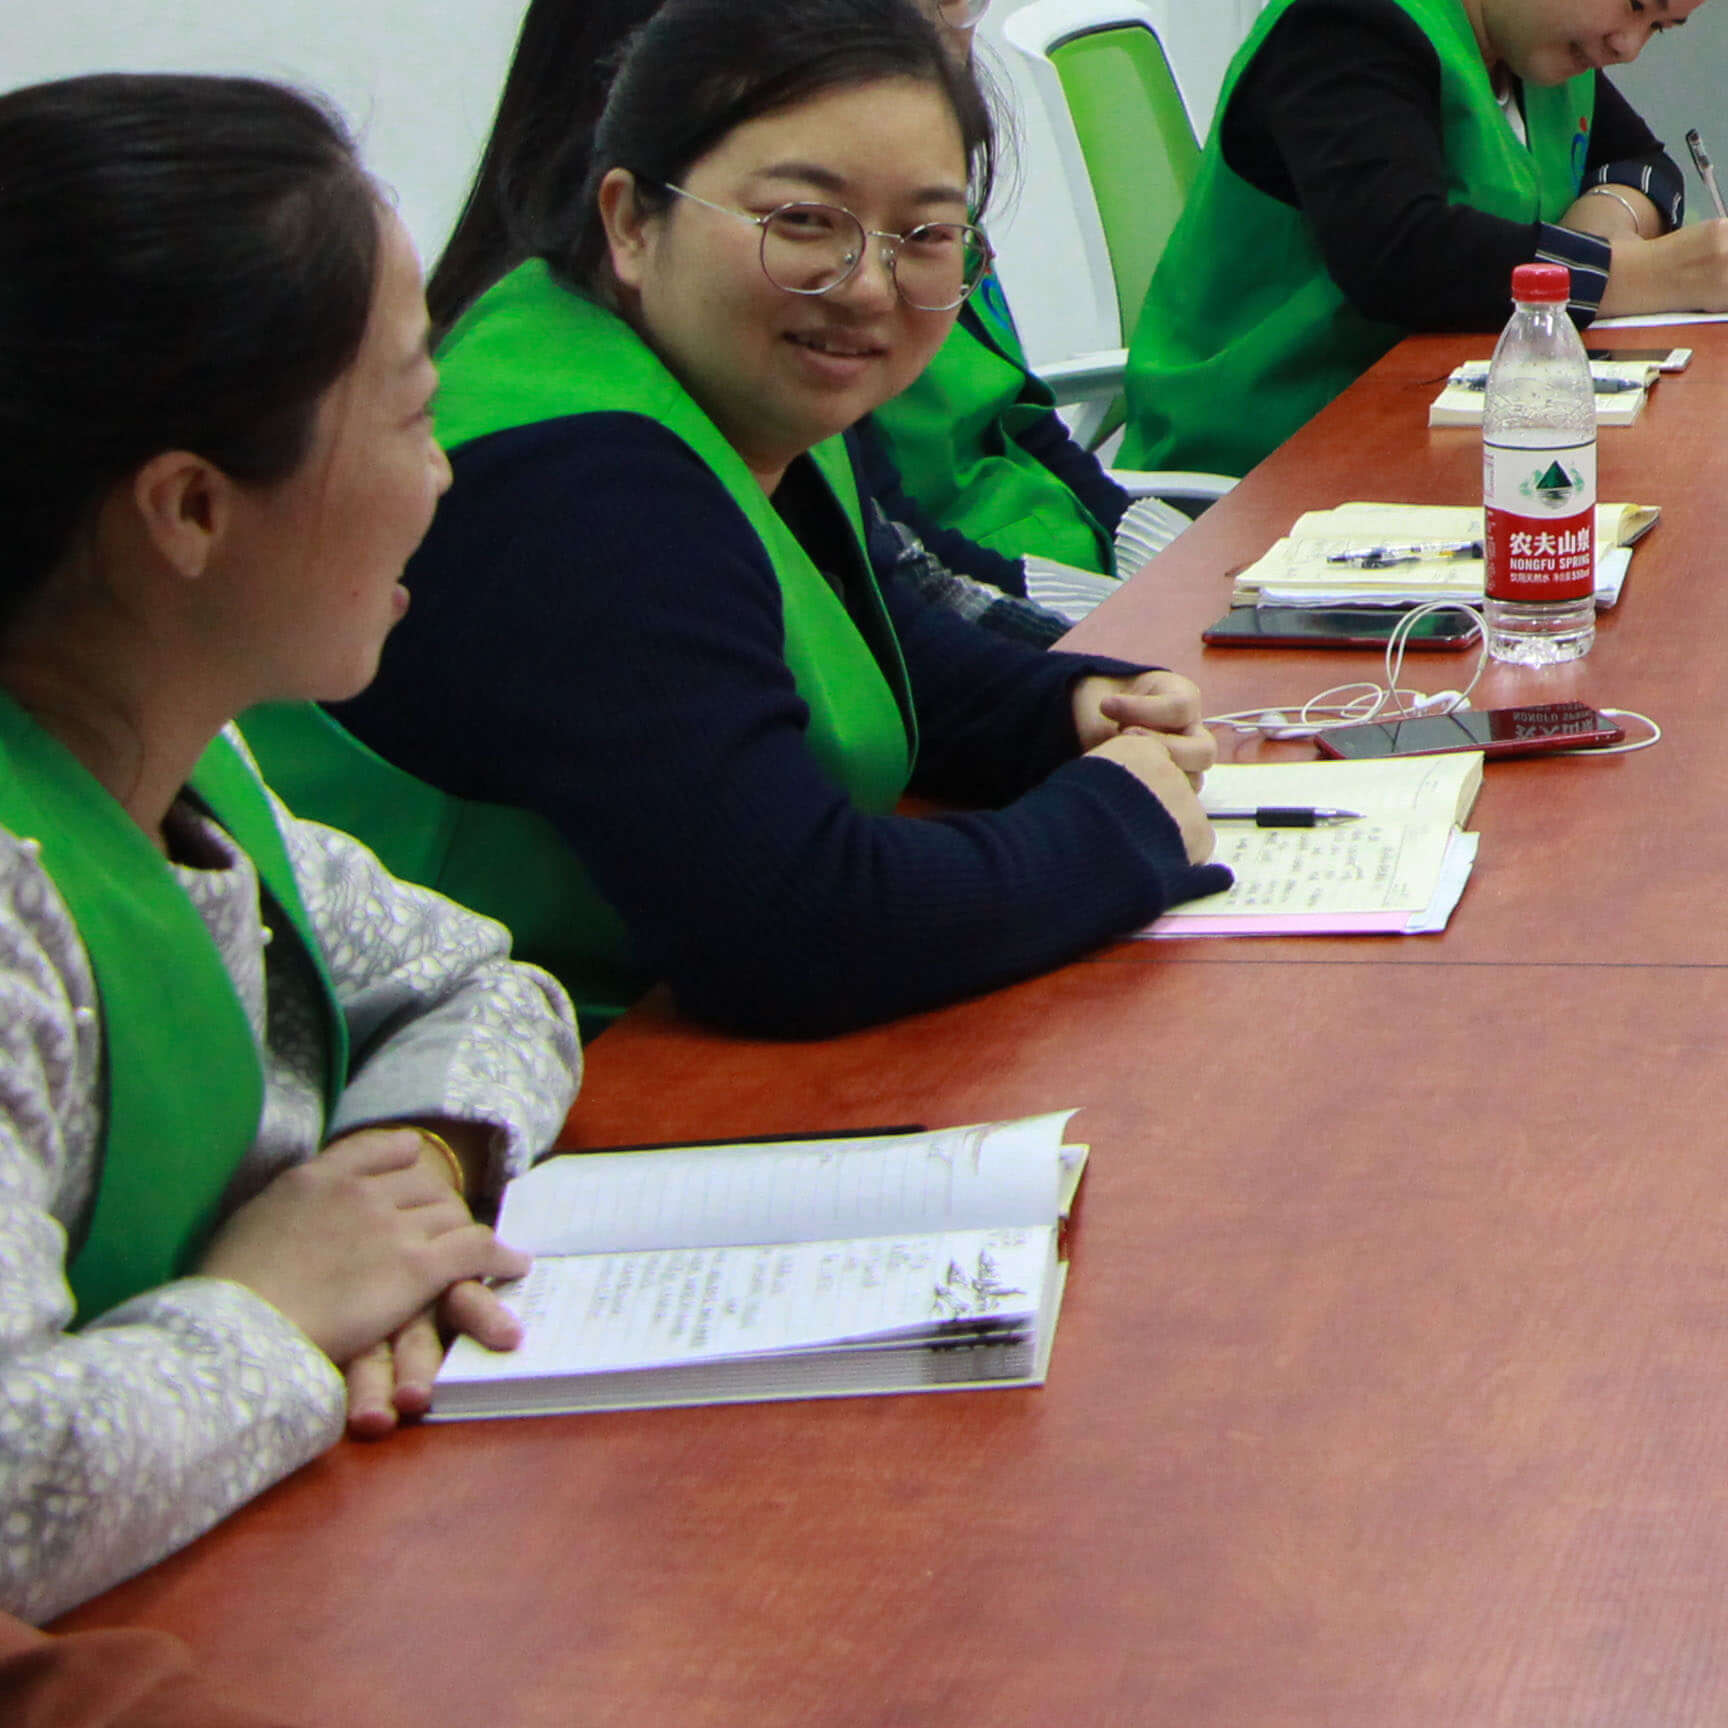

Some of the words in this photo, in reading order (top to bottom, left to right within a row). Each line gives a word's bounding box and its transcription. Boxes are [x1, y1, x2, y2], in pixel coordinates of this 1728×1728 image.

[1509, 527, 1590, 556] 农夫山泉
[1510, 557, 1555, 571] NONGFU
[1559, 553, 1590, 570] SPRING
